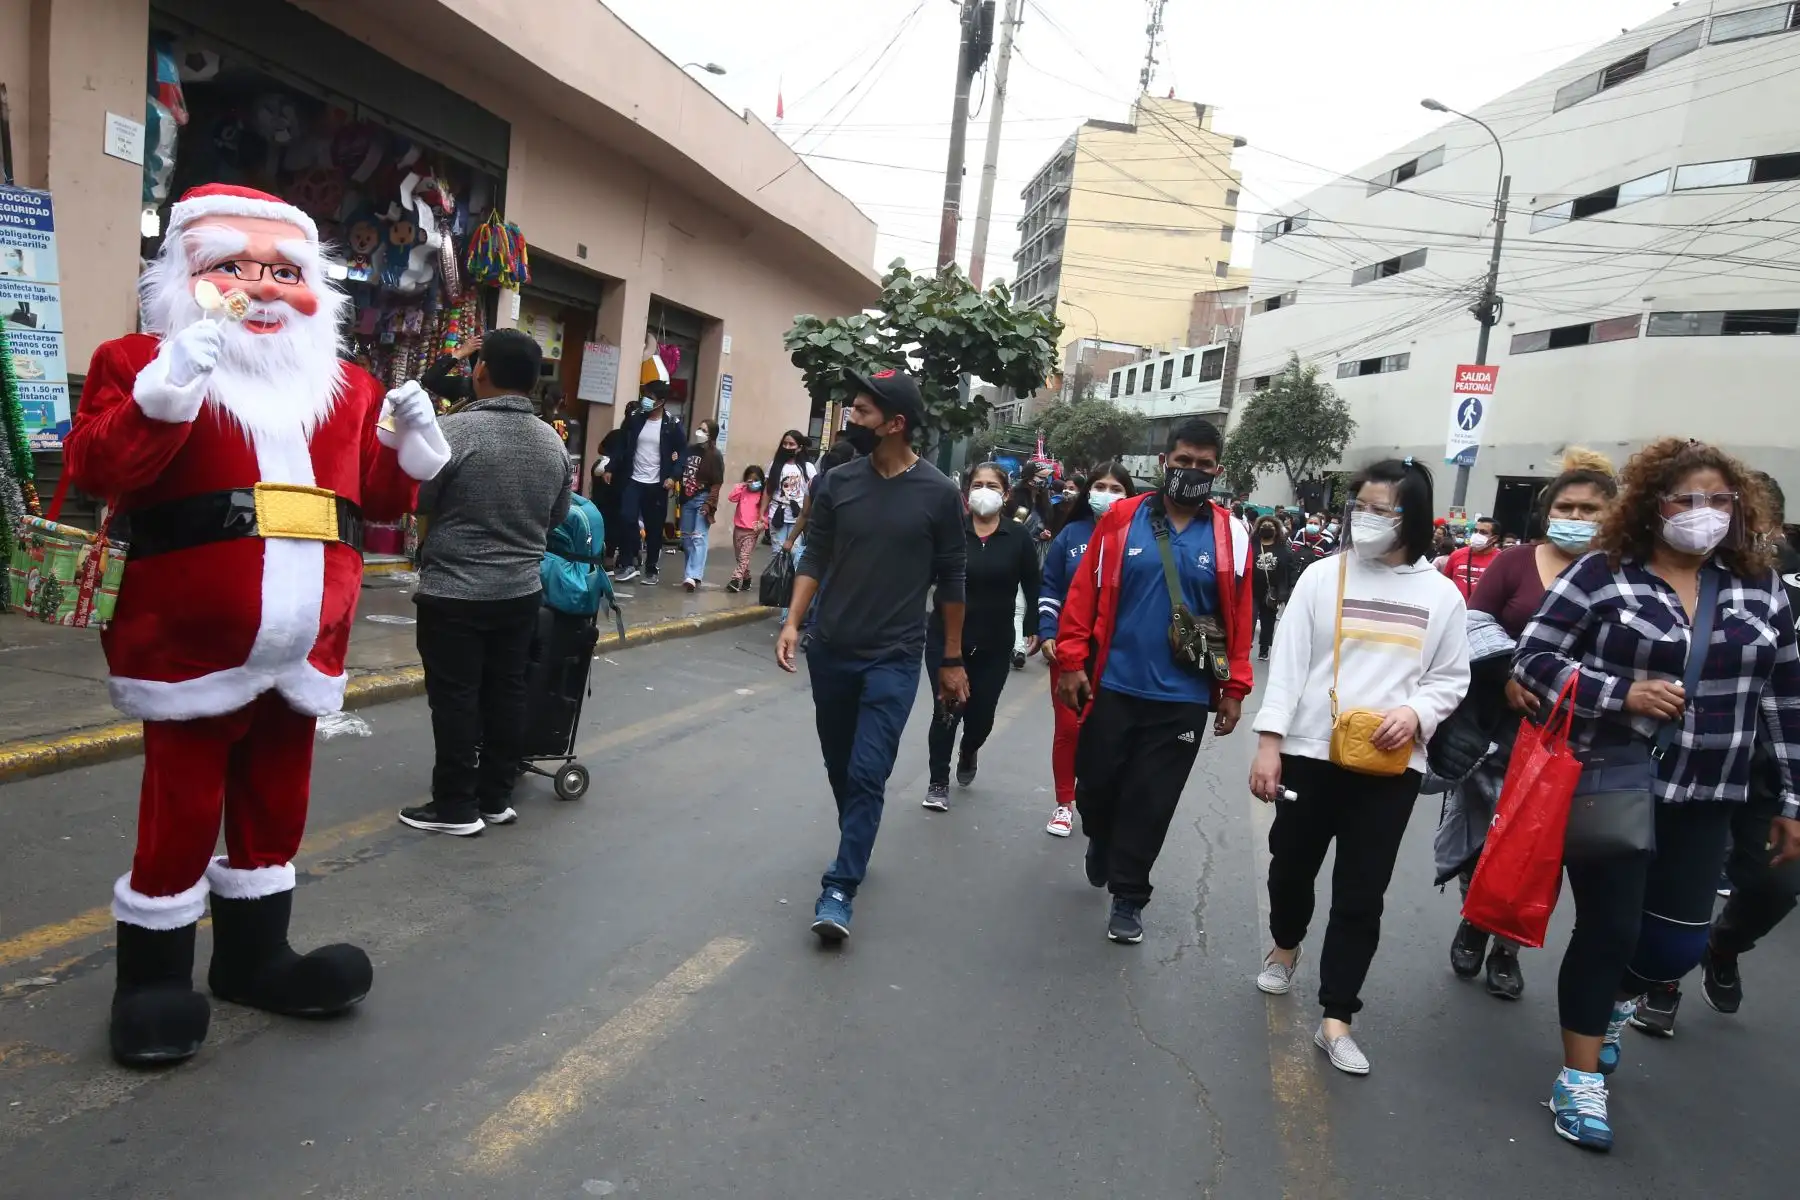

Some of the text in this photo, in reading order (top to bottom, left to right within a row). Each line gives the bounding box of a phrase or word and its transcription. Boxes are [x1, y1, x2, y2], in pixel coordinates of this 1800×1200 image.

[0, 229, 50, 242] obligatorio
[34, 285, 46, 293] tus
[10, 341, 39, 349] manos
[43, 349, 58, 358] gel
[1460, 372, 1491, 382] SALIDA
[1455, 382, 1493, 392] PEATONAL
